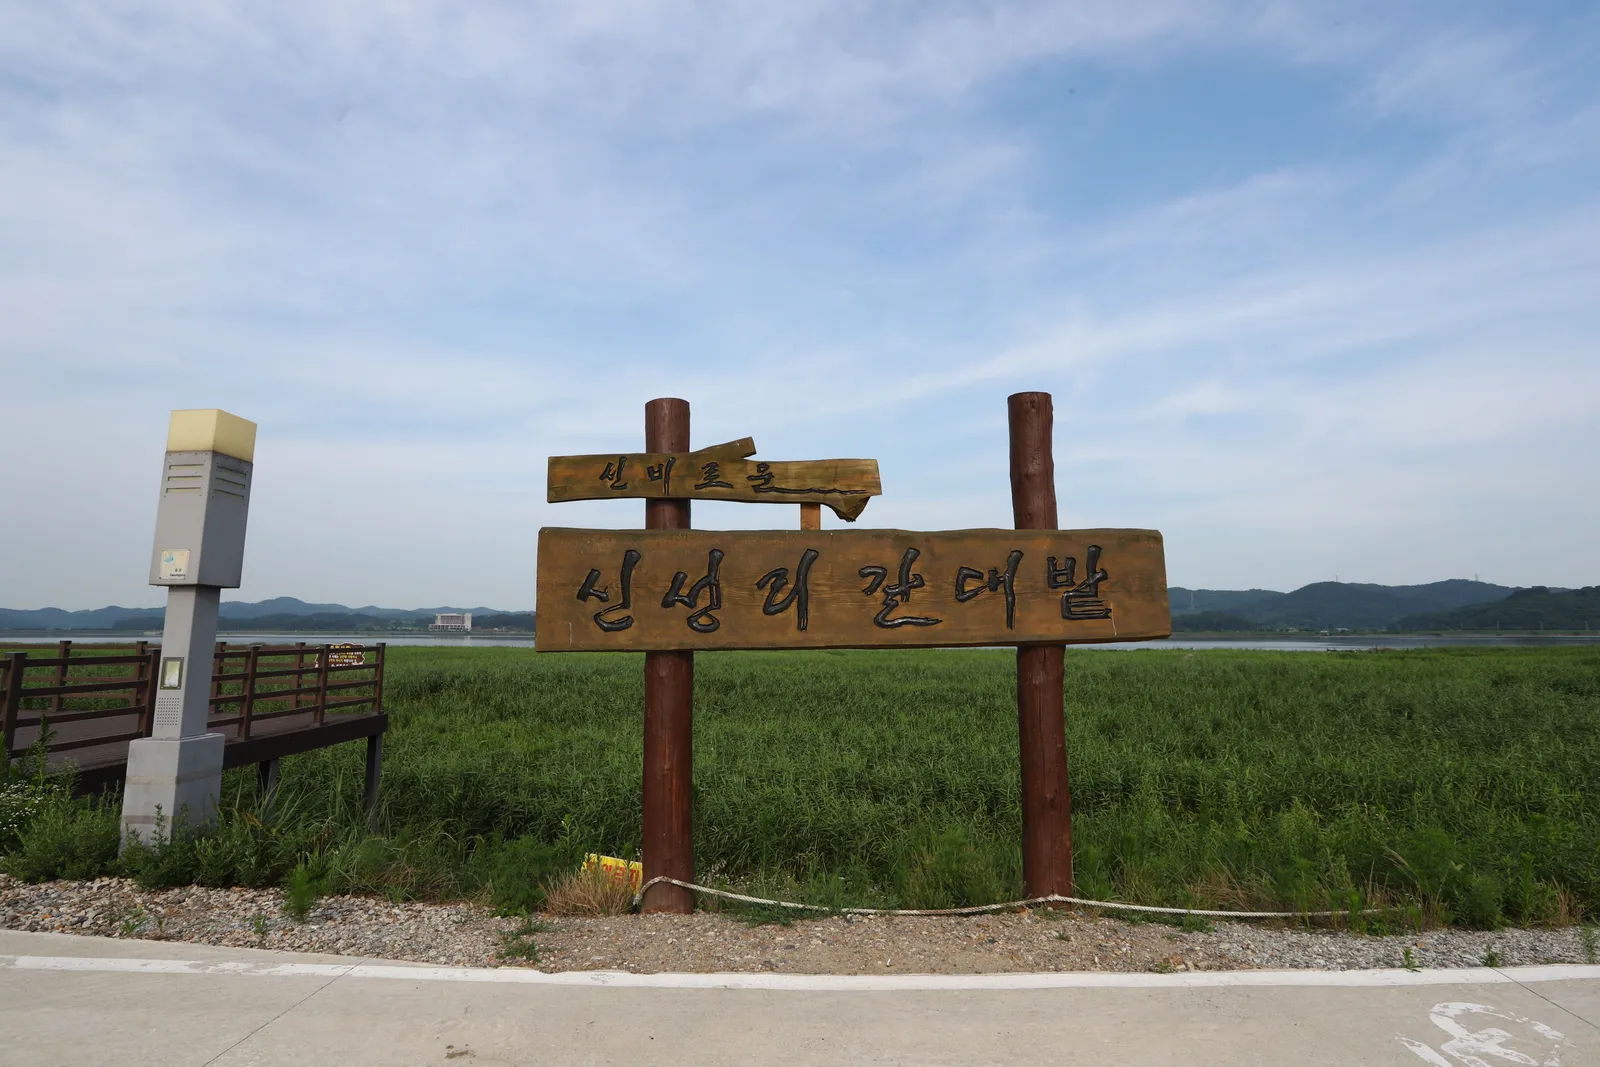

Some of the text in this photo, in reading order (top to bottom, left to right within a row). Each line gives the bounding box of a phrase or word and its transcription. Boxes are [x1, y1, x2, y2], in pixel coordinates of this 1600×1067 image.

[599, 456, 869, 496] 신비로운
[576, 545, 1112, 633] 신성리 갈대밭
